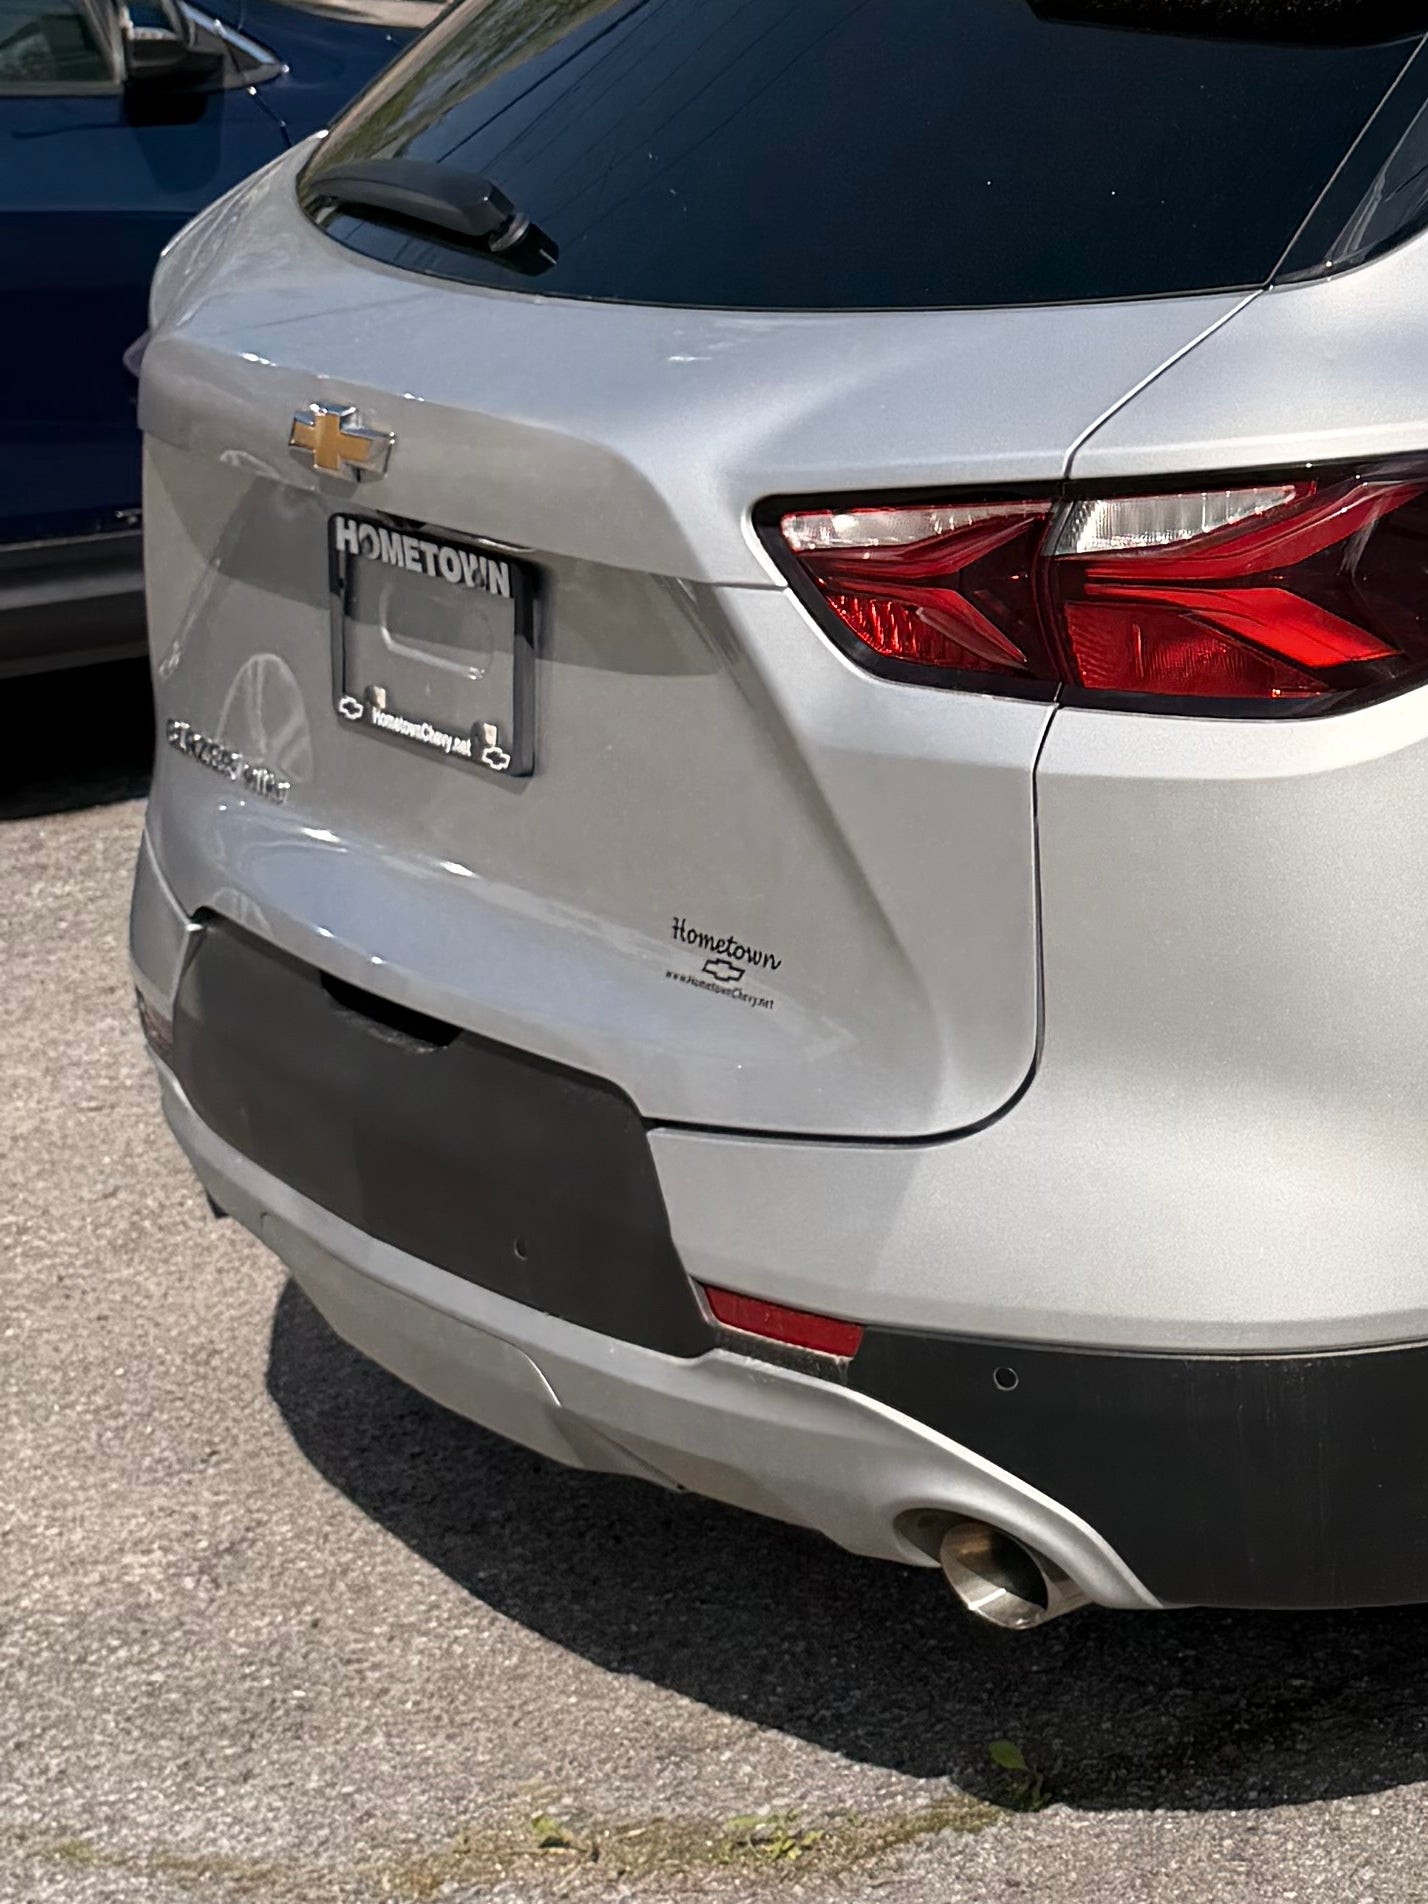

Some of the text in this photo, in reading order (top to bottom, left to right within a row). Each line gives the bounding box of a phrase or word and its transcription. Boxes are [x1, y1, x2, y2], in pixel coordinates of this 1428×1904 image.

[335, 515, 511, 598] HOMETOWN
[371, 708, 473, 757] HometownChevy.net
[672, 916, 782, 970] Hometown
